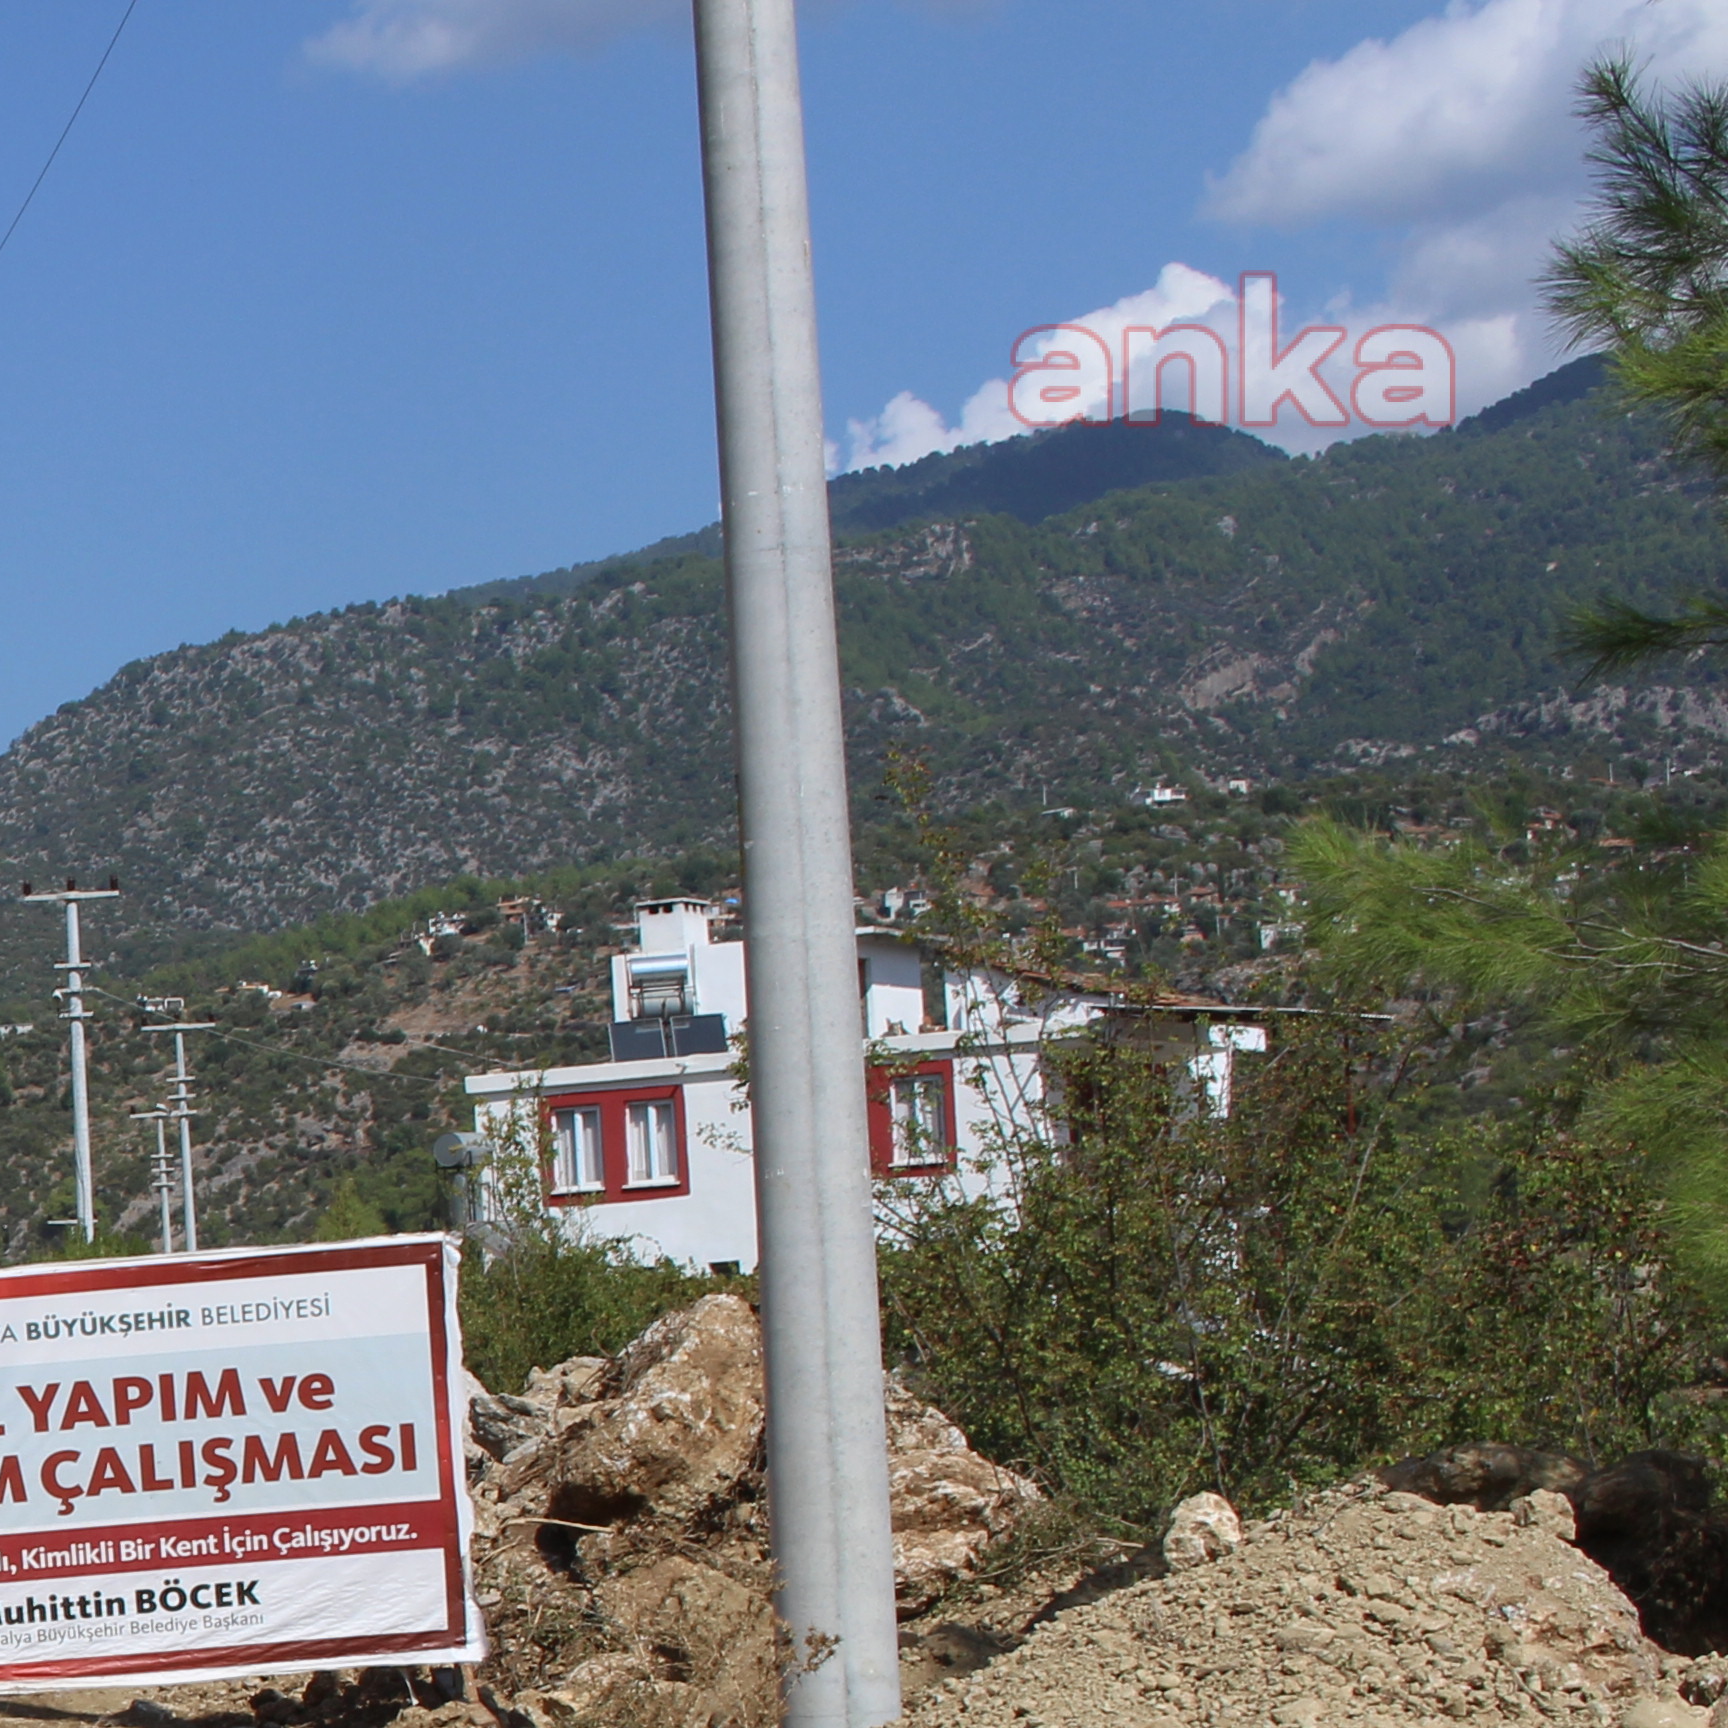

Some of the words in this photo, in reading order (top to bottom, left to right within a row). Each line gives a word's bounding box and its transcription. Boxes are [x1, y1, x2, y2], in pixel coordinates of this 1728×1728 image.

[25, 1302, 192, 1340] BÜYÜKŞEHİR
[200, 1292, 331, 1327] BELEDİYESİ
[16, 1368, 247, 1433] YAPIM
[258, 1372, 335, 1413] ve
[40, 1422, 417, 1516] ÇALIŞMASI
[21, 1540, 115, 1570] Kimlikli
[120, 1539, 155, 1562] Bir
[159, 1534, 218, 1559] Kent
[223, 1526, 268, 1558] İçin
[273, 1522, 418, 1556] Çalışıyoruz.
[135, 1578, 261, 1614] BÖCEK
[37, 1622, 125, 1644] Büyükşehir
[130, 1615, 198, 1636] Belediye
[203, 1612, 264, 1631] Başkanı
